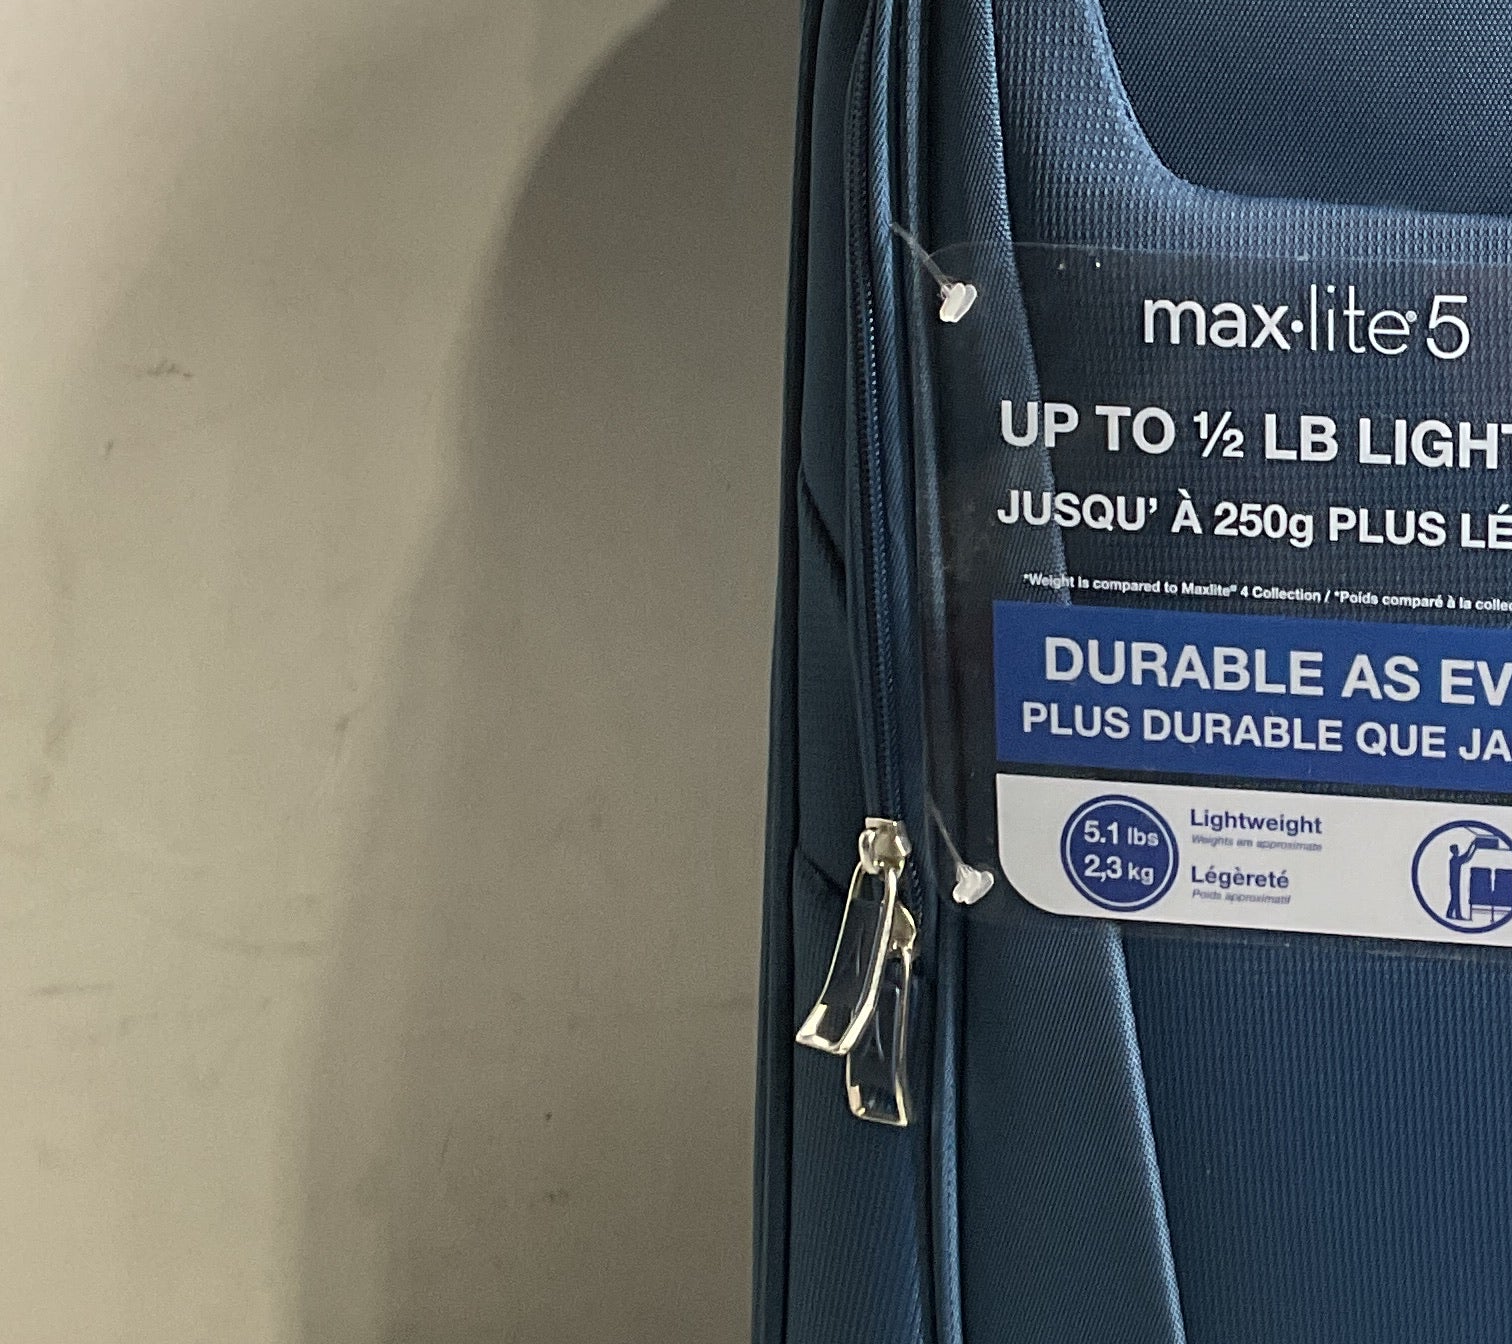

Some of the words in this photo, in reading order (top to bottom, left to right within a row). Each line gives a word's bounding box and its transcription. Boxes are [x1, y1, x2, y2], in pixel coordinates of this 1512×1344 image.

[1001, 399, 1079, 447] UP
[1095, 404, 1176, 455] TO
[1263, 413, 1339, 462] LB
[1170, 488, 1203, 535] À
[1213, 501, 1314, 549] 250g
[1328, 506, 1447, 548] PLUS
[1077, 576, 1090, 589] is
[1092, 578, 1161, 598] compared
[1164, 581, 1178, 594] to
[1239, 586, 1249, 598] 4
[1251, 585, 1321, 603] Collection
[1382, 594, 1443, 611] comparé
[1446, 595, 1456, 609] à
[1458, 596, 1472, 611] la
[1044, 636, 1324, 696] DURABLE
[1340, 653, 1421, 702] AS
[1022, 700, 1131, 739] PLUS
[1142, 708, 1343, 752] DURABLE
[1355, 721, 1447, 759] QUE
[1083, 819, 1119, 845] 5.1
[1126, 825, 1160, 847] lbs
[1189, 808, 1323, 837] Lightweight
[1083, 853, 1122, 883] 2,3
[1127, 862, 1154, 886] kg
[1190, 864, 1290, 890] Légèreté
